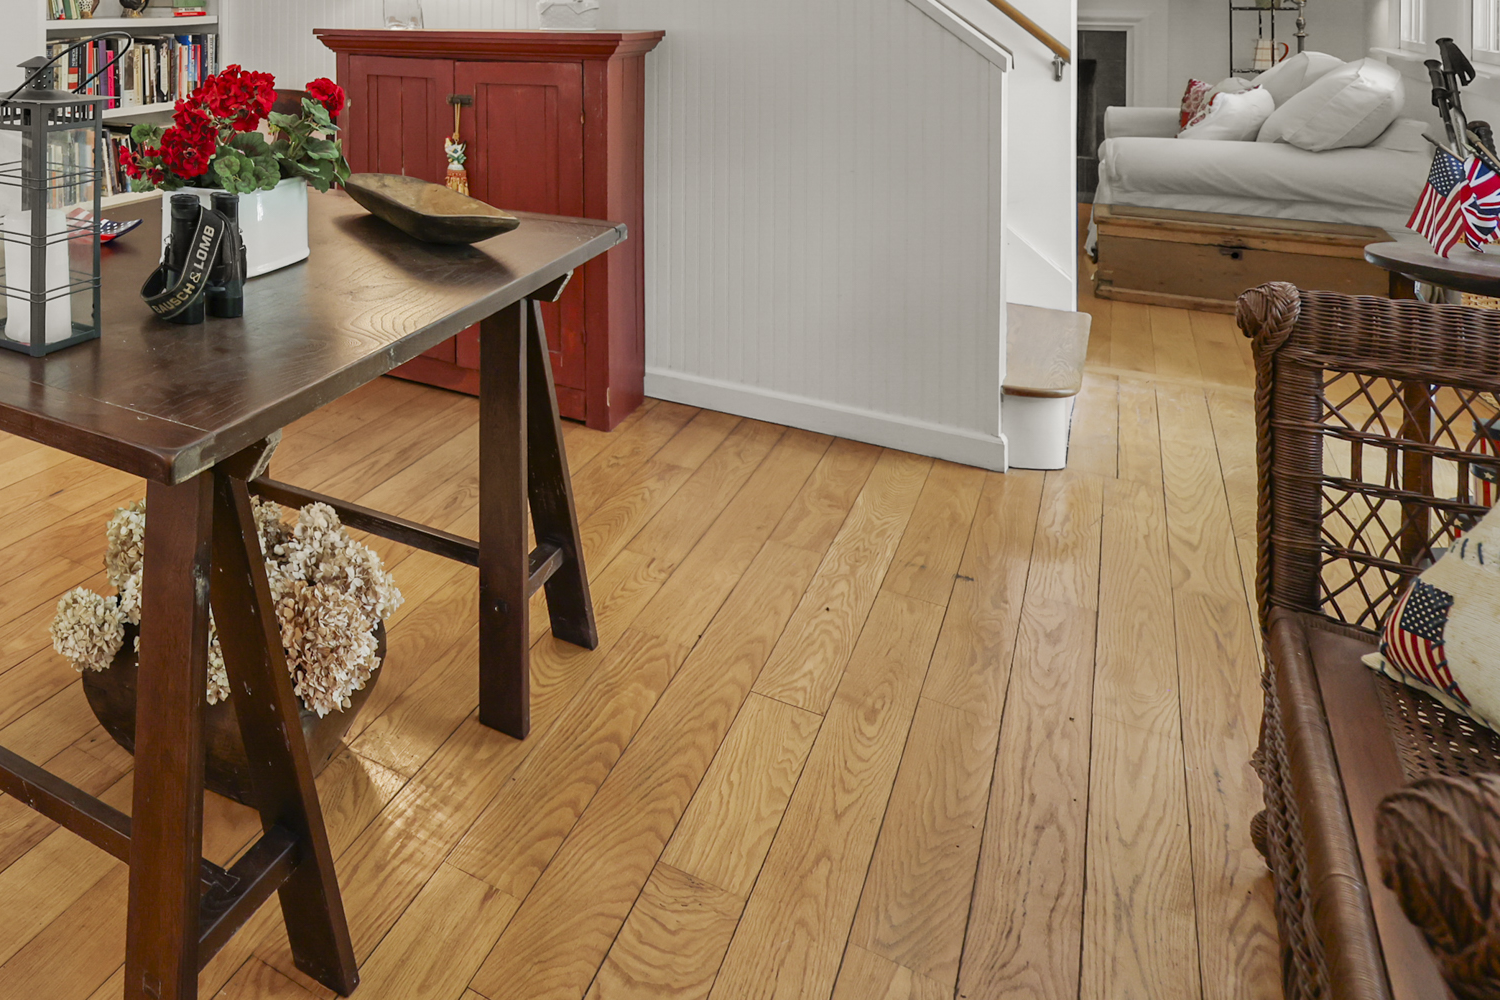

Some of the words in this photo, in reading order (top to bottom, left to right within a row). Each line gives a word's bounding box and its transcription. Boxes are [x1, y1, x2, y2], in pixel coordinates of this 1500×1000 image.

[194, 225, 215, 270] LOMB
[190, 271, 202, 283] &
[152, 283, 195, 314] BAUSCH
